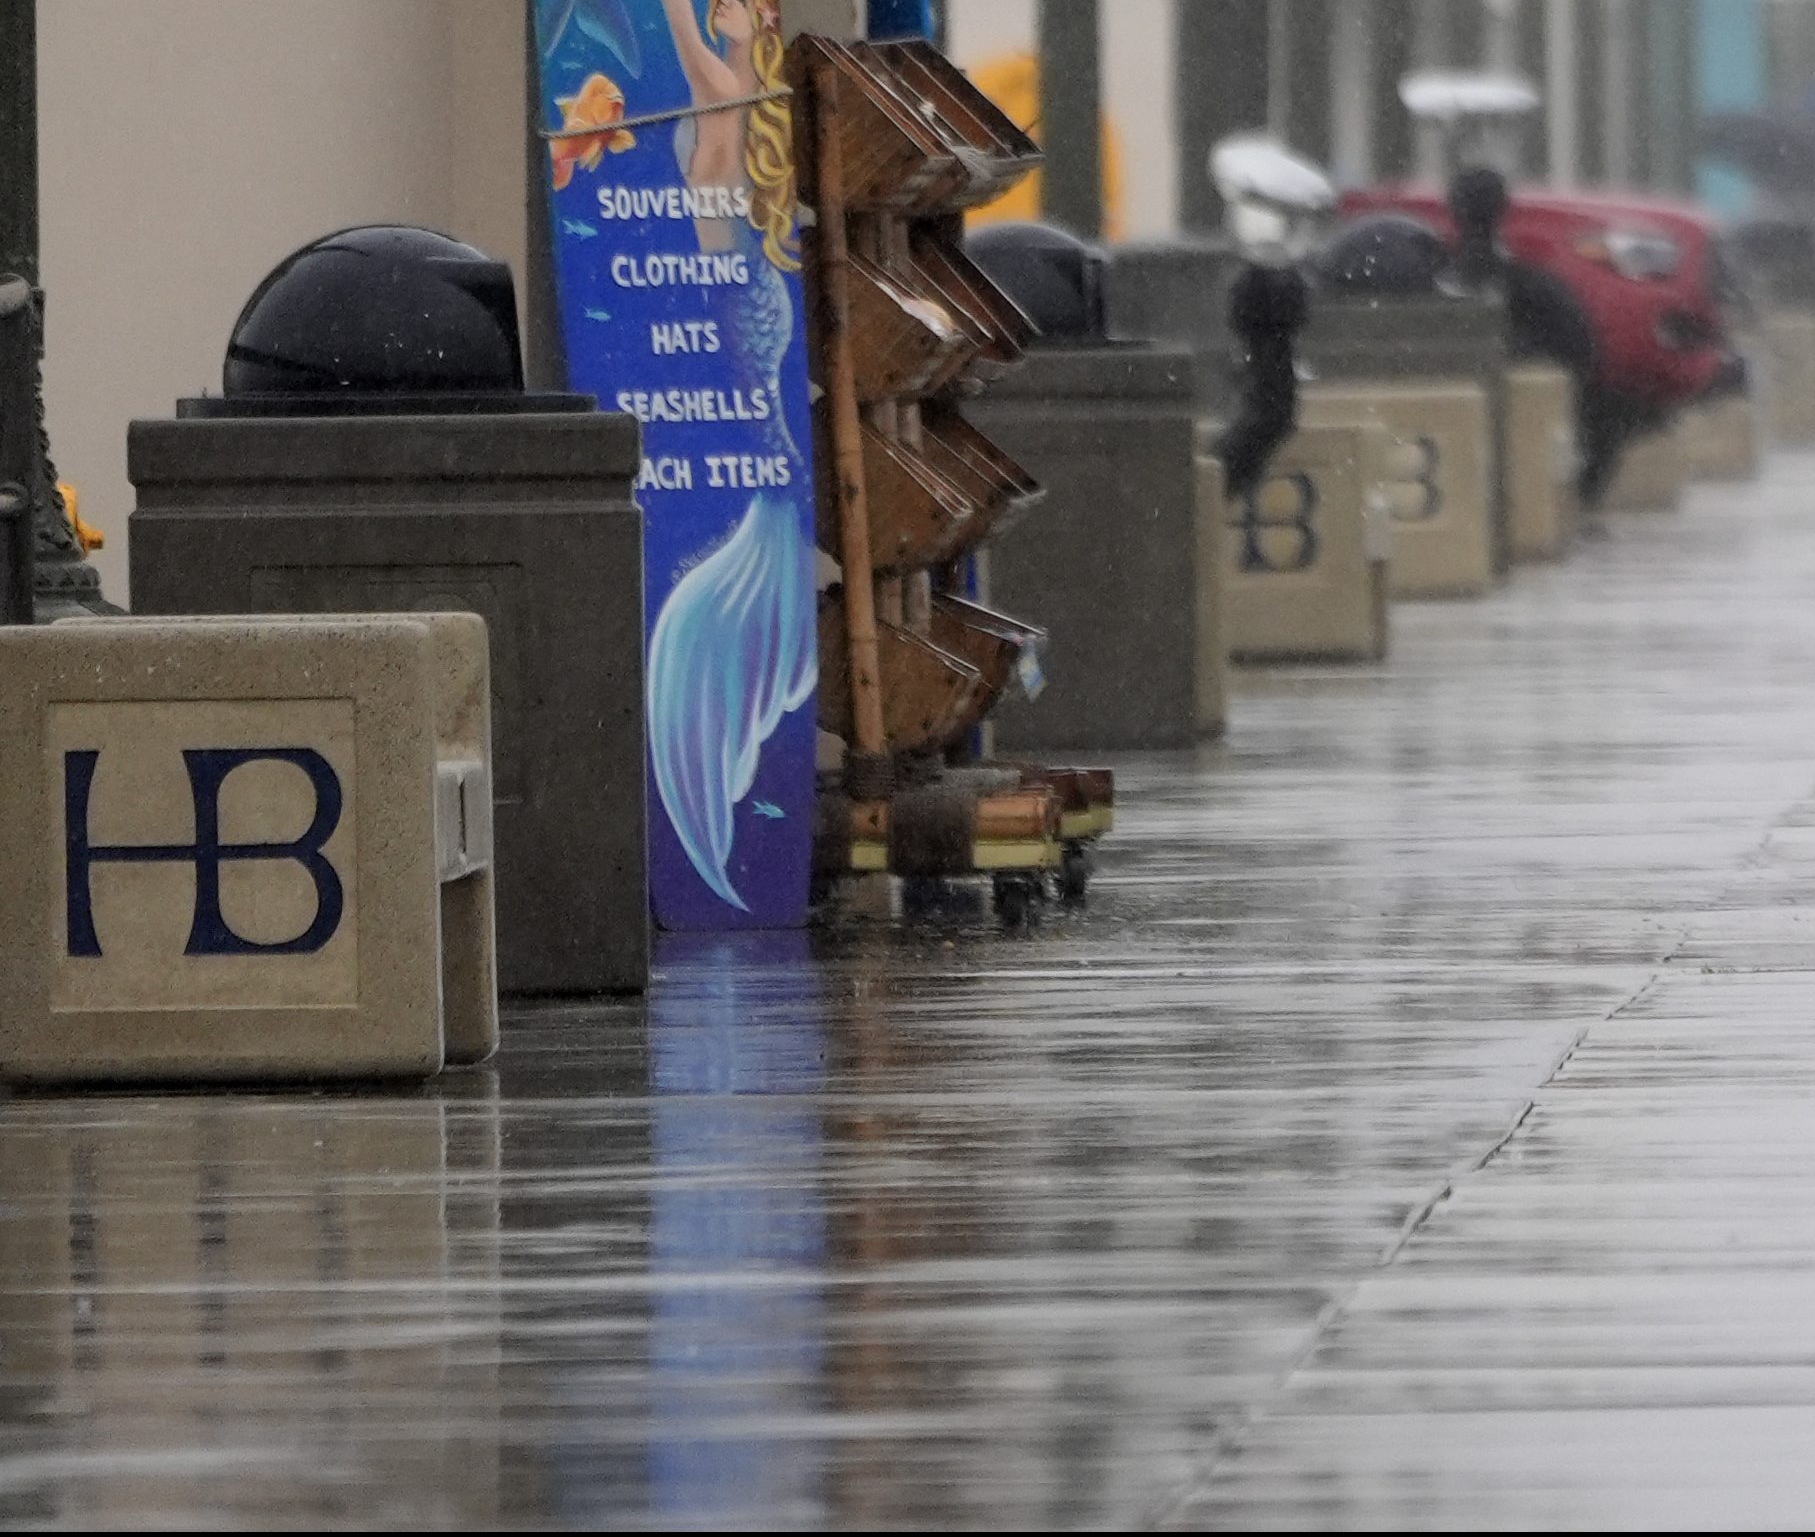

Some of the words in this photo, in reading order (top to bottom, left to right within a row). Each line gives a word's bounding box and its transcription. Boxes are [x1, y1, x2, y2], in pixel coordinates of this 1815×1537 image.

[597, 186, 751, 220] SOUVENIRS
[611, 253, 749, 288] CLOTHING
[651, 320, 721, 355] HATS
[616, 388, 771, 423] SEASHELLS
[632, 457, 693, 491] ACH
[704, 456, 792, 489] ITEMS
[64, 748, 344, 958] HB
